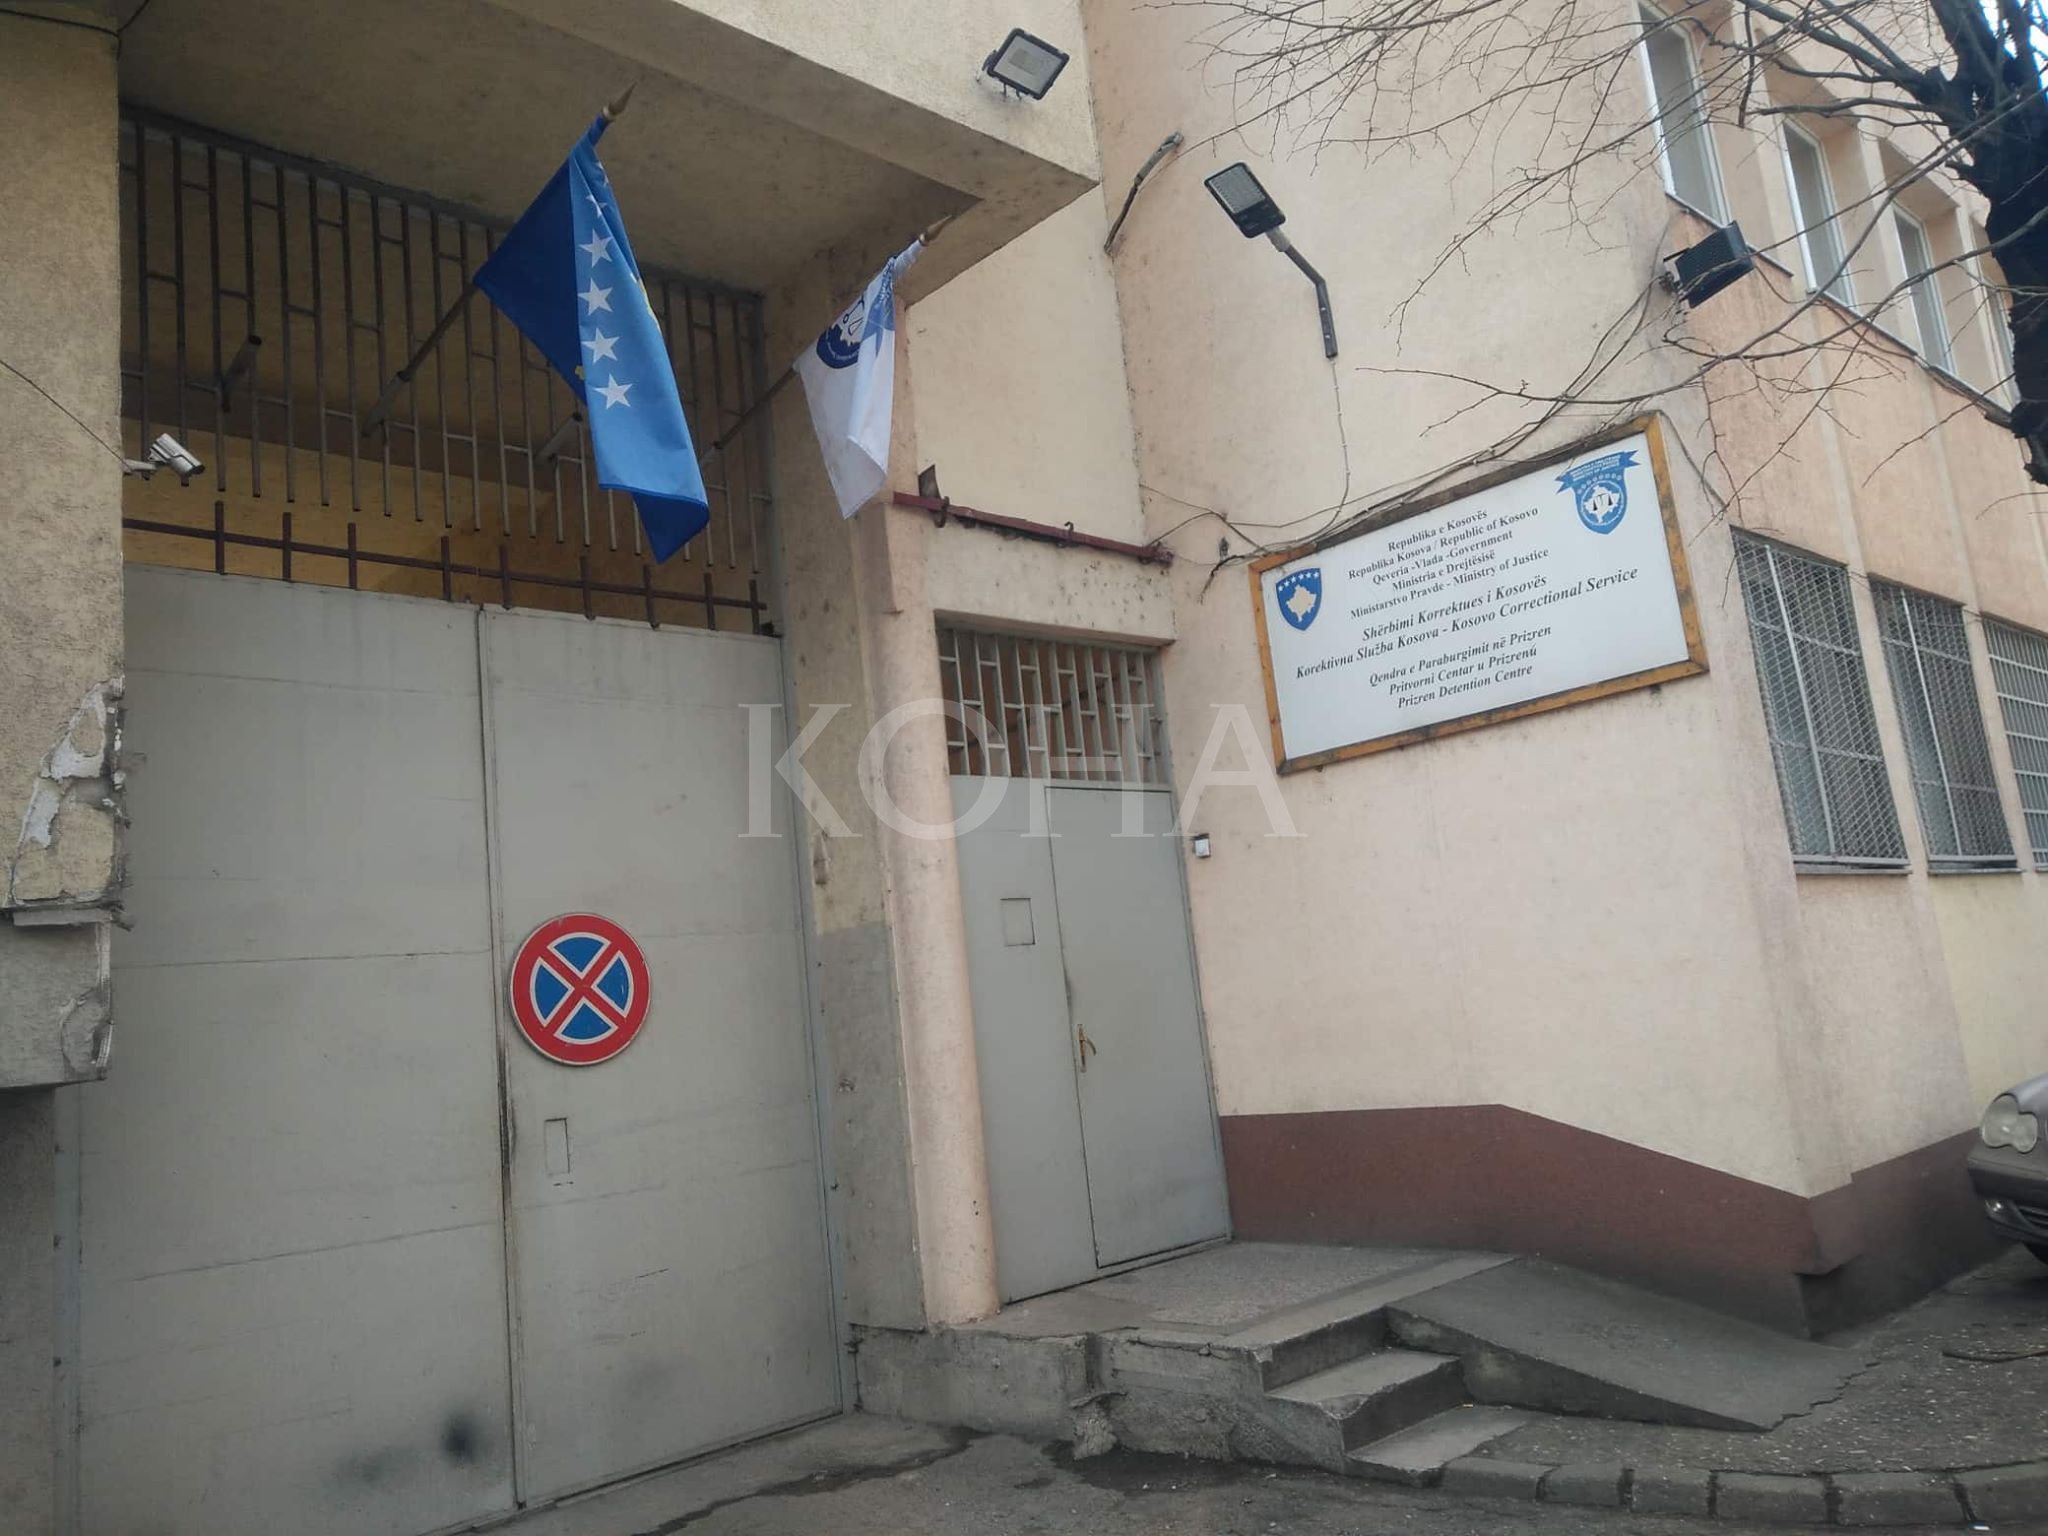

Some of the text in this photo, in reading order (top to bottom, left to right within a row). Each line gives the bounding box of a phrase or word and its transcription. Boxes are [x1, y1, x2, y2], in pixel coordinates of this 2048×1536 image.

[1348, 557, 1395, 580] Republika
[1396, 545, 1432, 563] Kosova
[1439, 525, 1484, 548] Republic
[1486, 519, 1498, 532] of
[1498, 507, 1539, 527] Kosovo
[1388, 529, 1437, 553] Republika
[1446, 510, 1488, 532] Kosovës
[1350, 595, 1408, 620] Ministarstvo
[1452, 566, 1496, 584] Ministry
[1499, 558, 1510, 571] of
[1511, 549, 1549, 567] Justice
[1372, 565, 1410, 586] Qeveria
[1392, 570, 1437, 591] Ministria
[1296, 654, 1354, 679] Korektivna
[1356, 640, 1394, 661] Služba
[1397, 628, 1439, 649] Kosova
[1451, 611, 1496, 633] Kosovo
[1499, 581, 1583, 618] Correctional
[1585, 568, 1638, 593] Service
[1362, 613, 1414, 642] Shërbimi
[1417, 596, 1484, 625] Korrektues
[1495, 574, 1547, 601] Kosovës
[1369, 667, 1407, 688] Qendra
[1418, 641, 1490, 672] Paraburgimit
[1509, 626, 1552, 646] Prizren
[1437, 664, 1475, 682] Centar
[1398, 665, 1533, 709] Prizren Detention Centre
